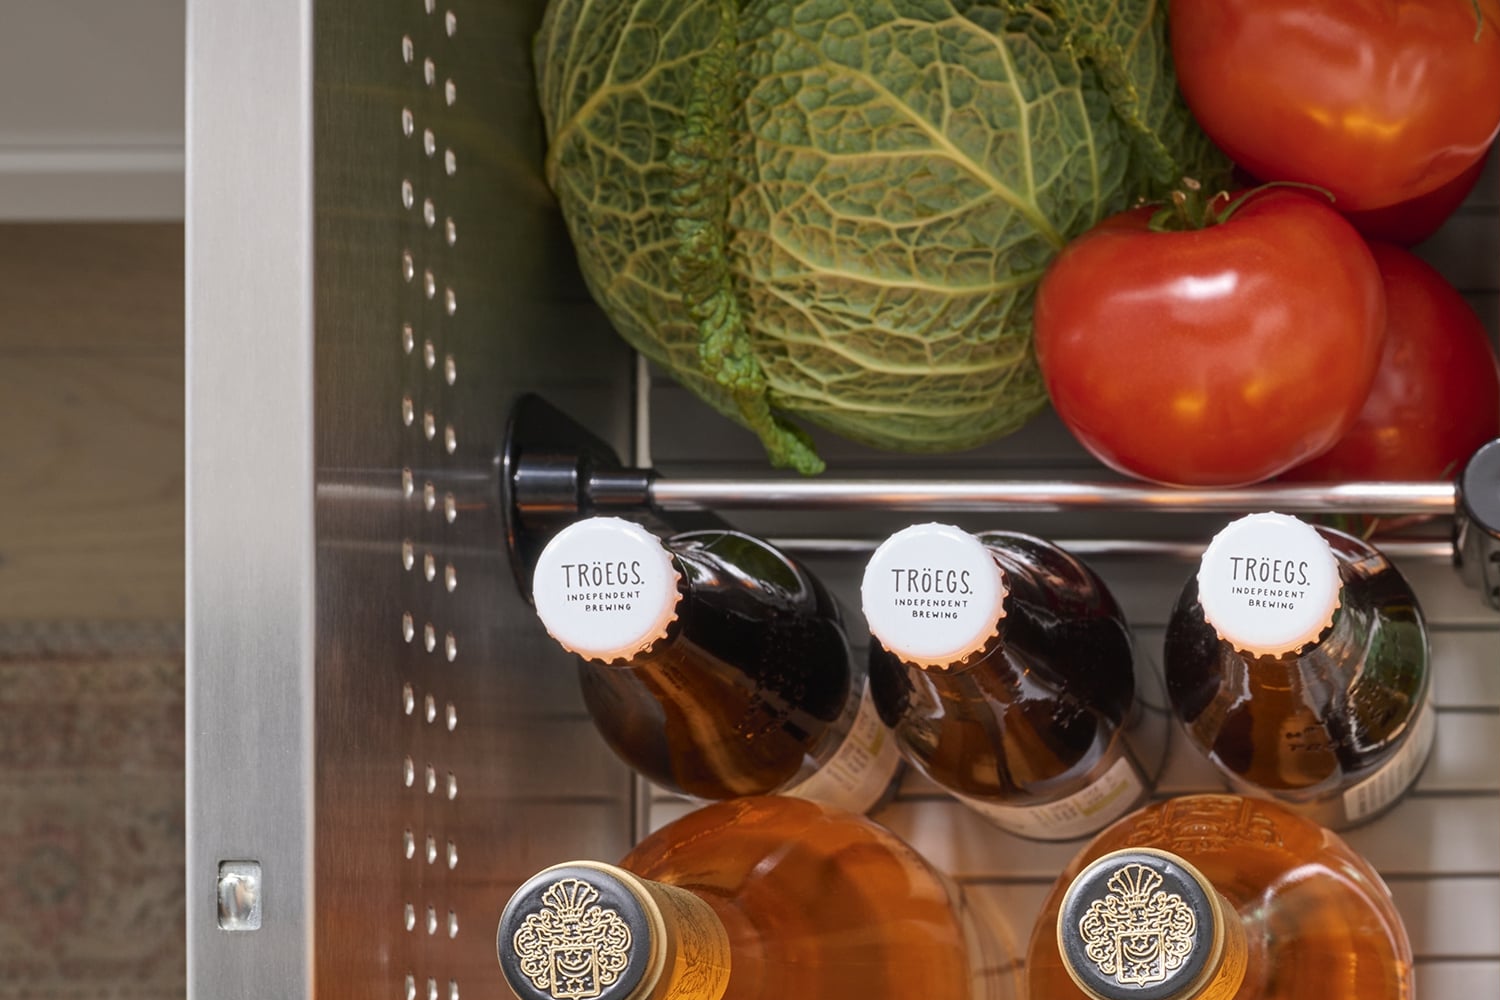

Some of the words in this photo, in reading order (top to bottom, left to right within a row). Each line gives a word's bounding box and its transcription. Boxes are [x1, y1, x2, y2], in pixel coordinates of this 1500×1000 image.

[566, 590, 641, 602] INDEPENDENT
[1231, 586, 1305, 600] INDEPENDENT
[585, 603, 632, 613] BREWING
[894, 598, 969, 608] INDEPENDENT
[1247, 598, 1295, 611] BREWING
[911, 609, 959, 620] BREWING
